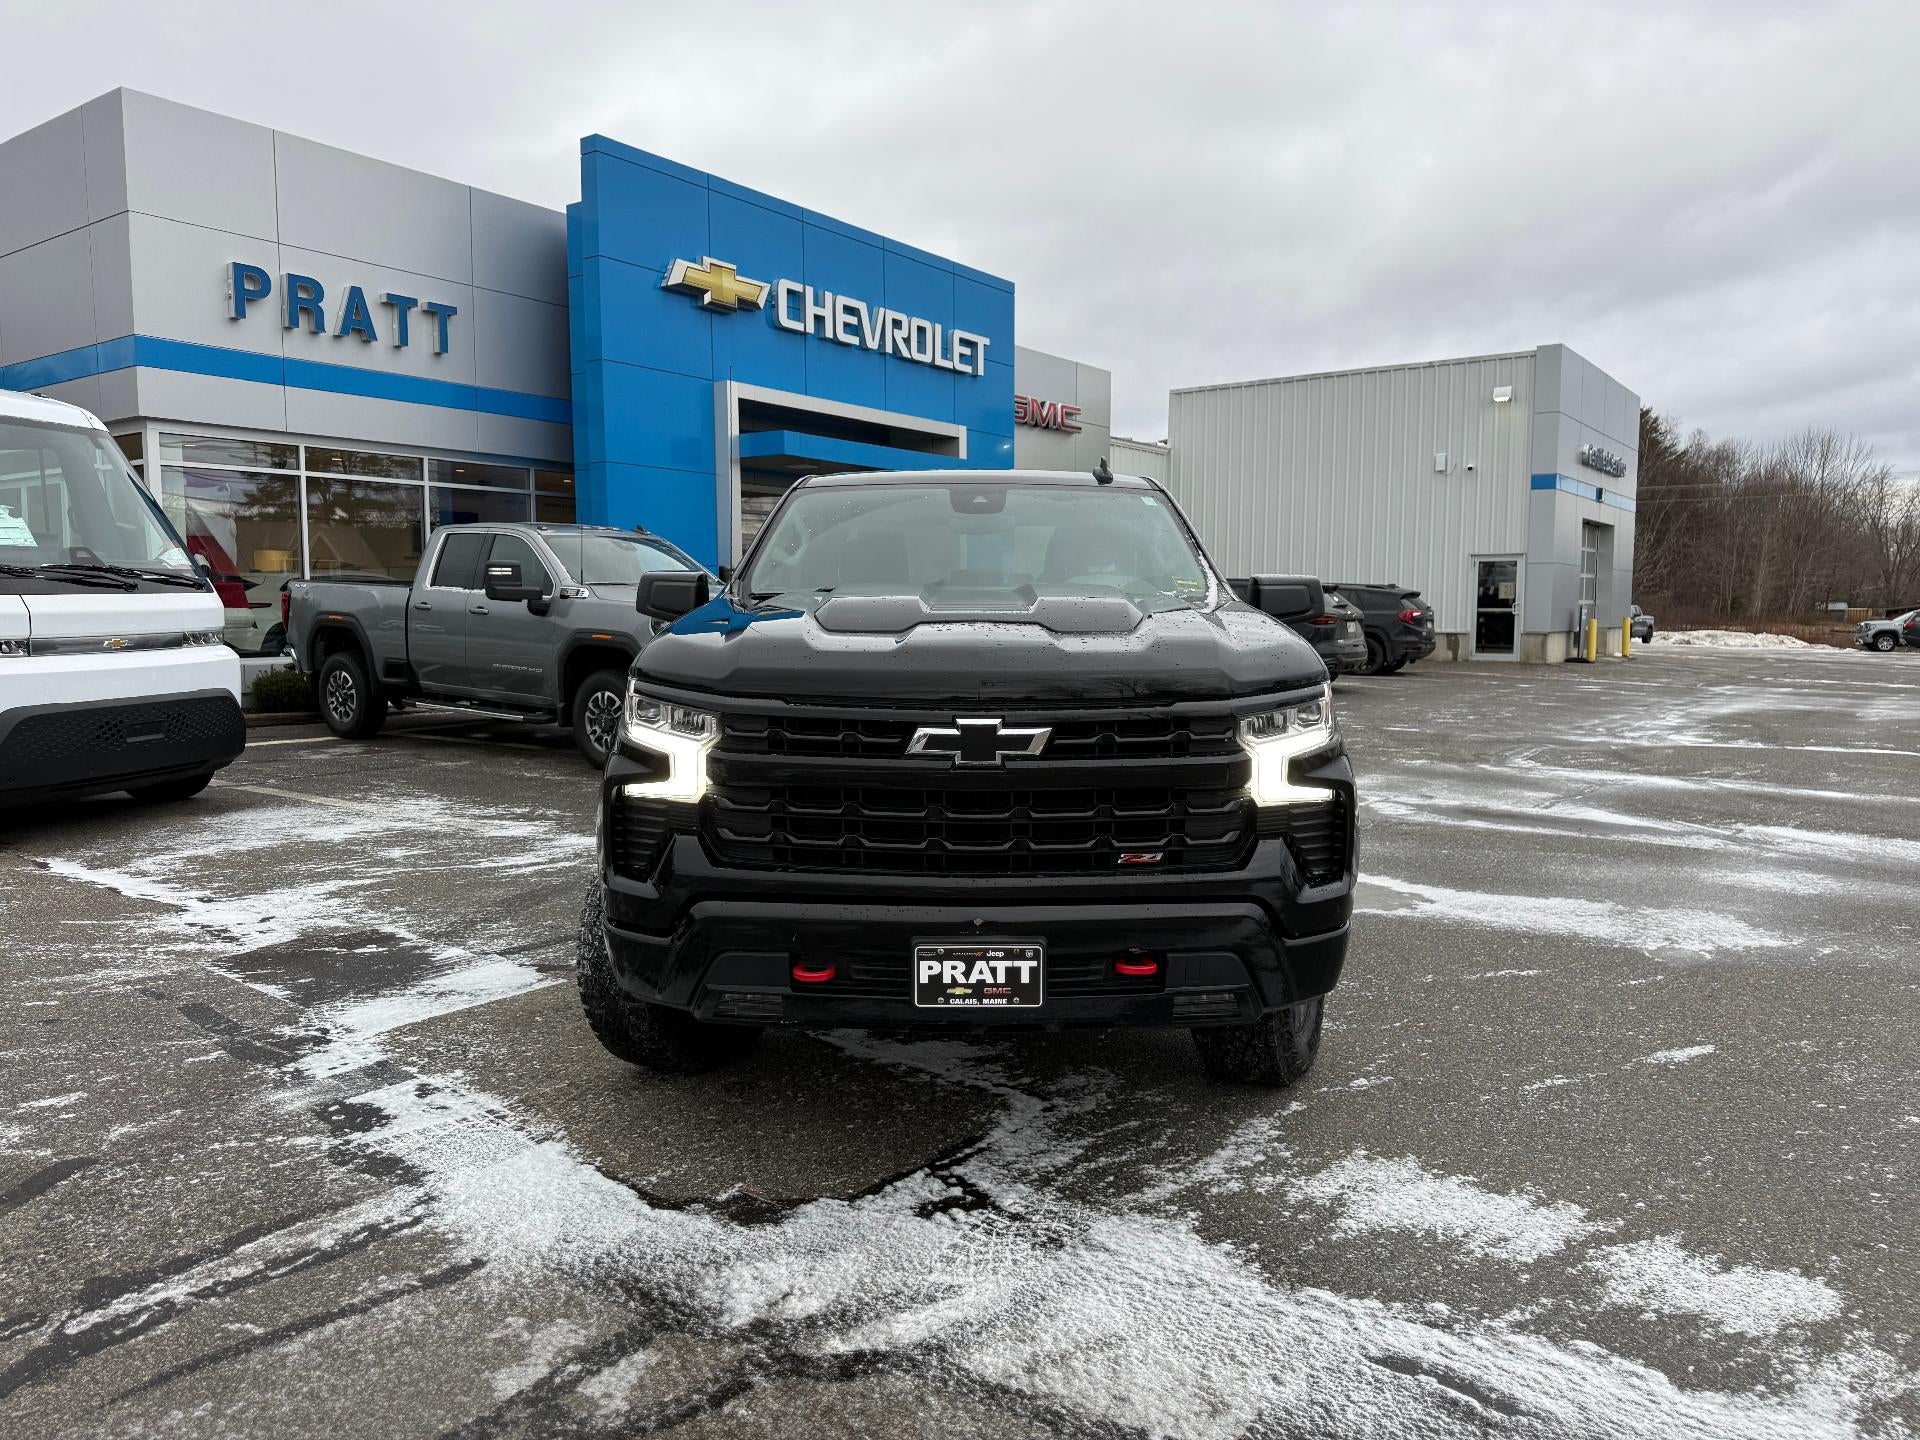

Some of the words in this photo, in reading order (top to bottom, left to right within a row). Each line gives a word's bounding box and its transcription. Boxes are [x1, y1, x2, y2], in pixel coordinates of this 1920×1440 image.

[226, 262, 458, 354] PRATT
[772, 278, 991, 377] CHEVROLET
[919, 960, 1038, 984] PRATT
[949, 998, 980, 1006] CALAIS,
